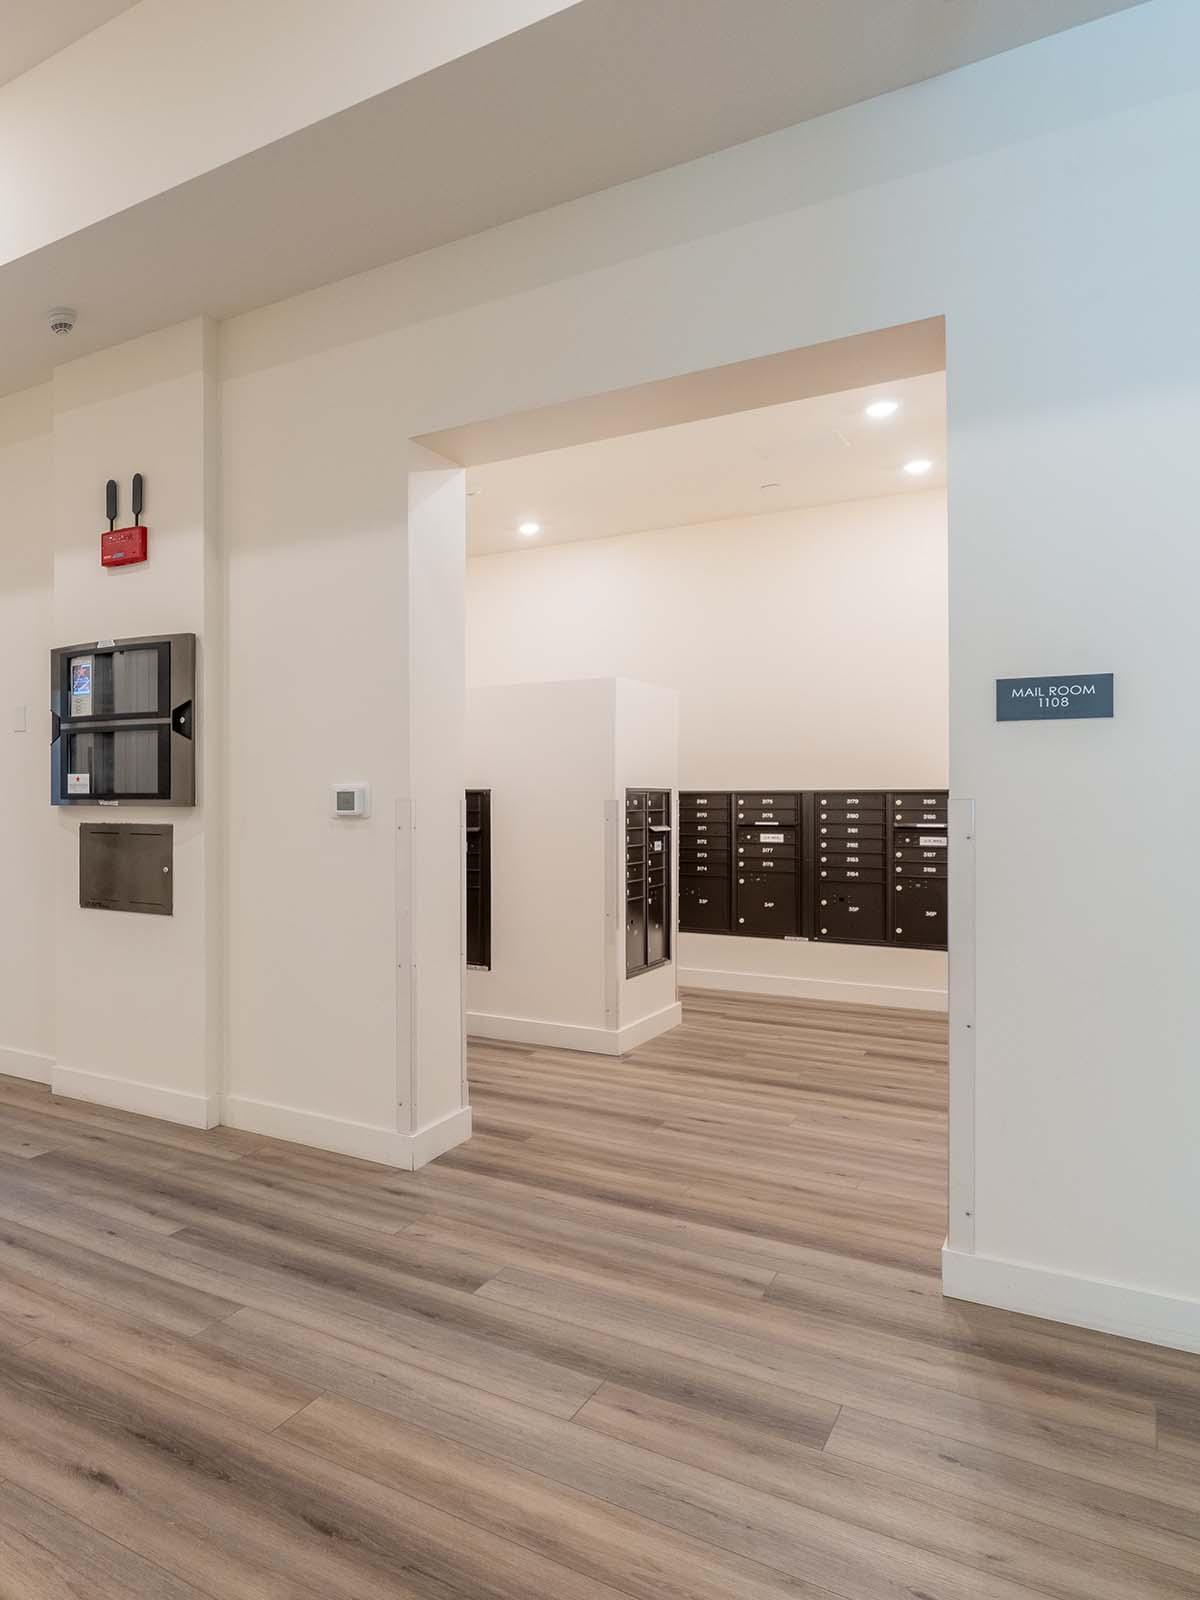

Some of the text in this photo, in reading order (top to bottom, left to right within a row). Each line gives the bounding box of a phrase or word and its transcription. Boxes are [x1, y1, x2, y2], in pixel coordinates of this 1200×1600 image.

[1012, 685, 1096, 698] MAIL ROOM
[1039, 697, 1069, 708] 1108
